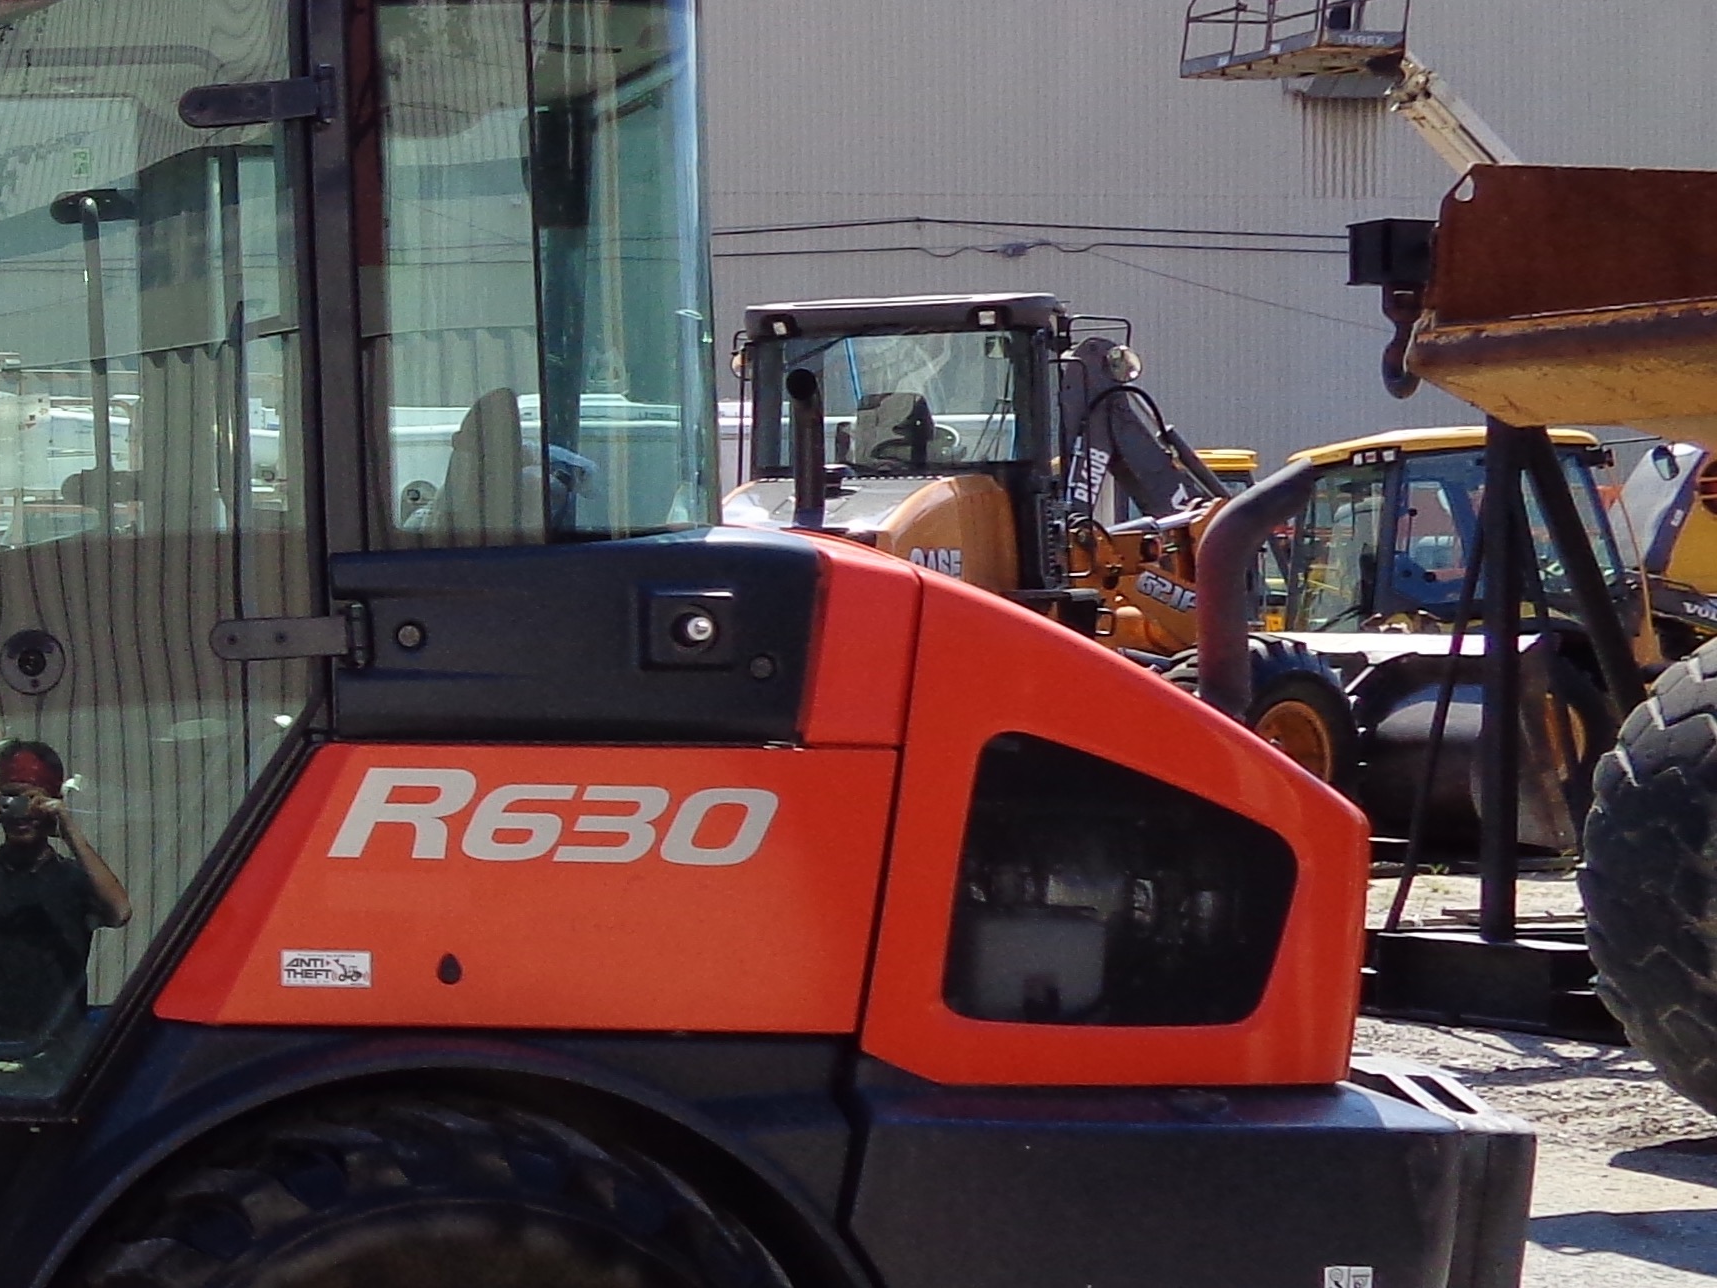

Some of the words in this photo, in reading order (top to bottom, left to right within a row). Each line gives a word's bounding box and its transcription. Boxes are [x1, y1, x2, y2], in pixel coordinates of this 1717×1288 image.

[327, 767, 779, 865] R630
[285, 958, 324, 968] ANTI
[283, 968, 332, 979] THEFT
